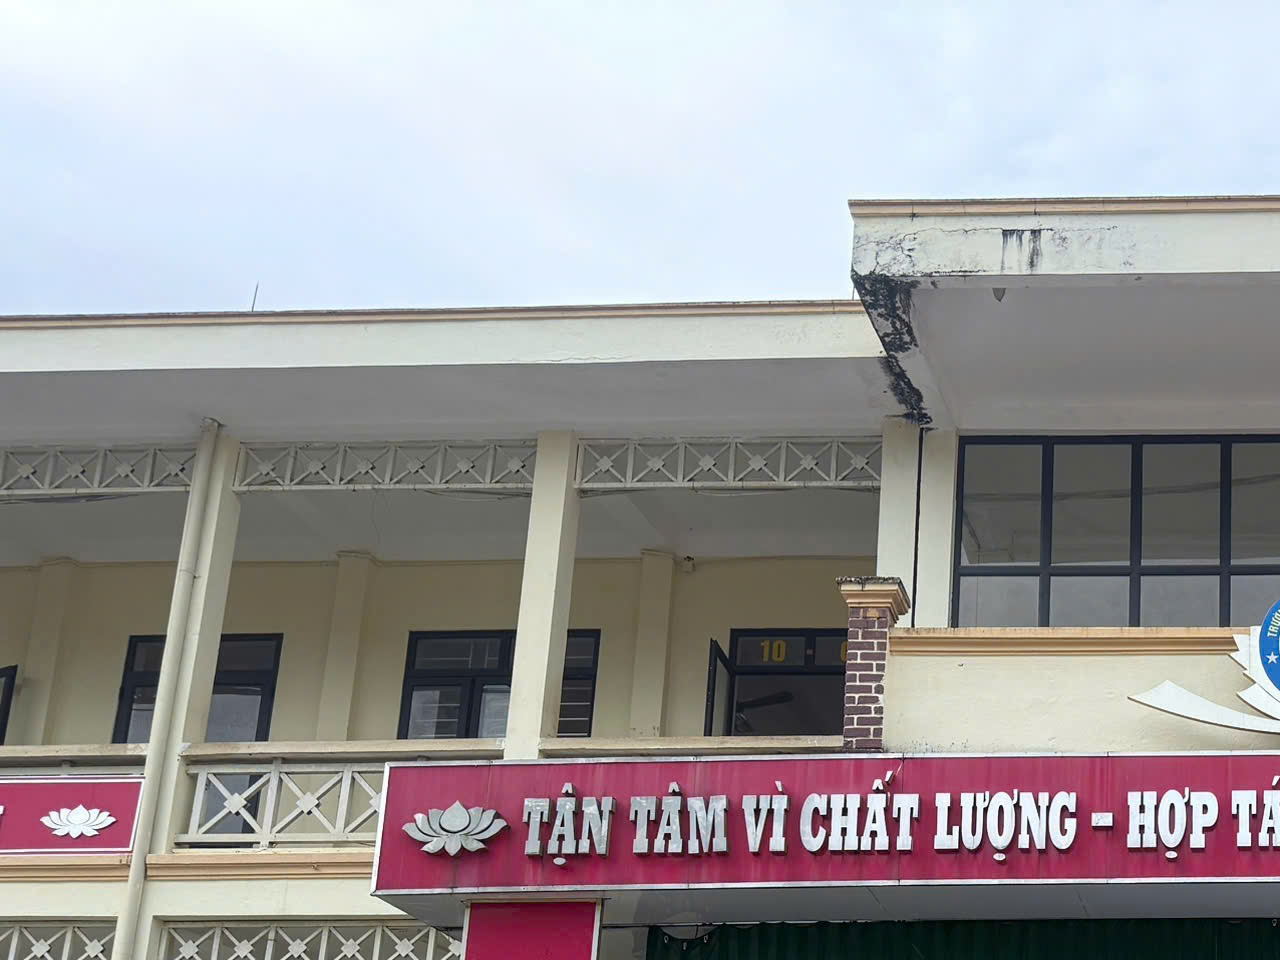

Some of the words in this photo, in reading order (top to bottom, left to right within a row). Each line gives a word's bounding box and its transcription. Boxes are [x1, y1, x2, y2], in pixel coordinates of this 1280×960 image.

[760, 639, 787, 663] 10
[522, 782, 616, 866] TẬN
[630, 781, 728, 855] TÂM
[742, 780, 789, 855] VÌ
[801, 771, 920, 853] CHẤT
[934, 788, 1078, 861] LƯỢNG
[1092, 812, 1114, 828] -
[1127, 786, 1219, 859] HỢP
